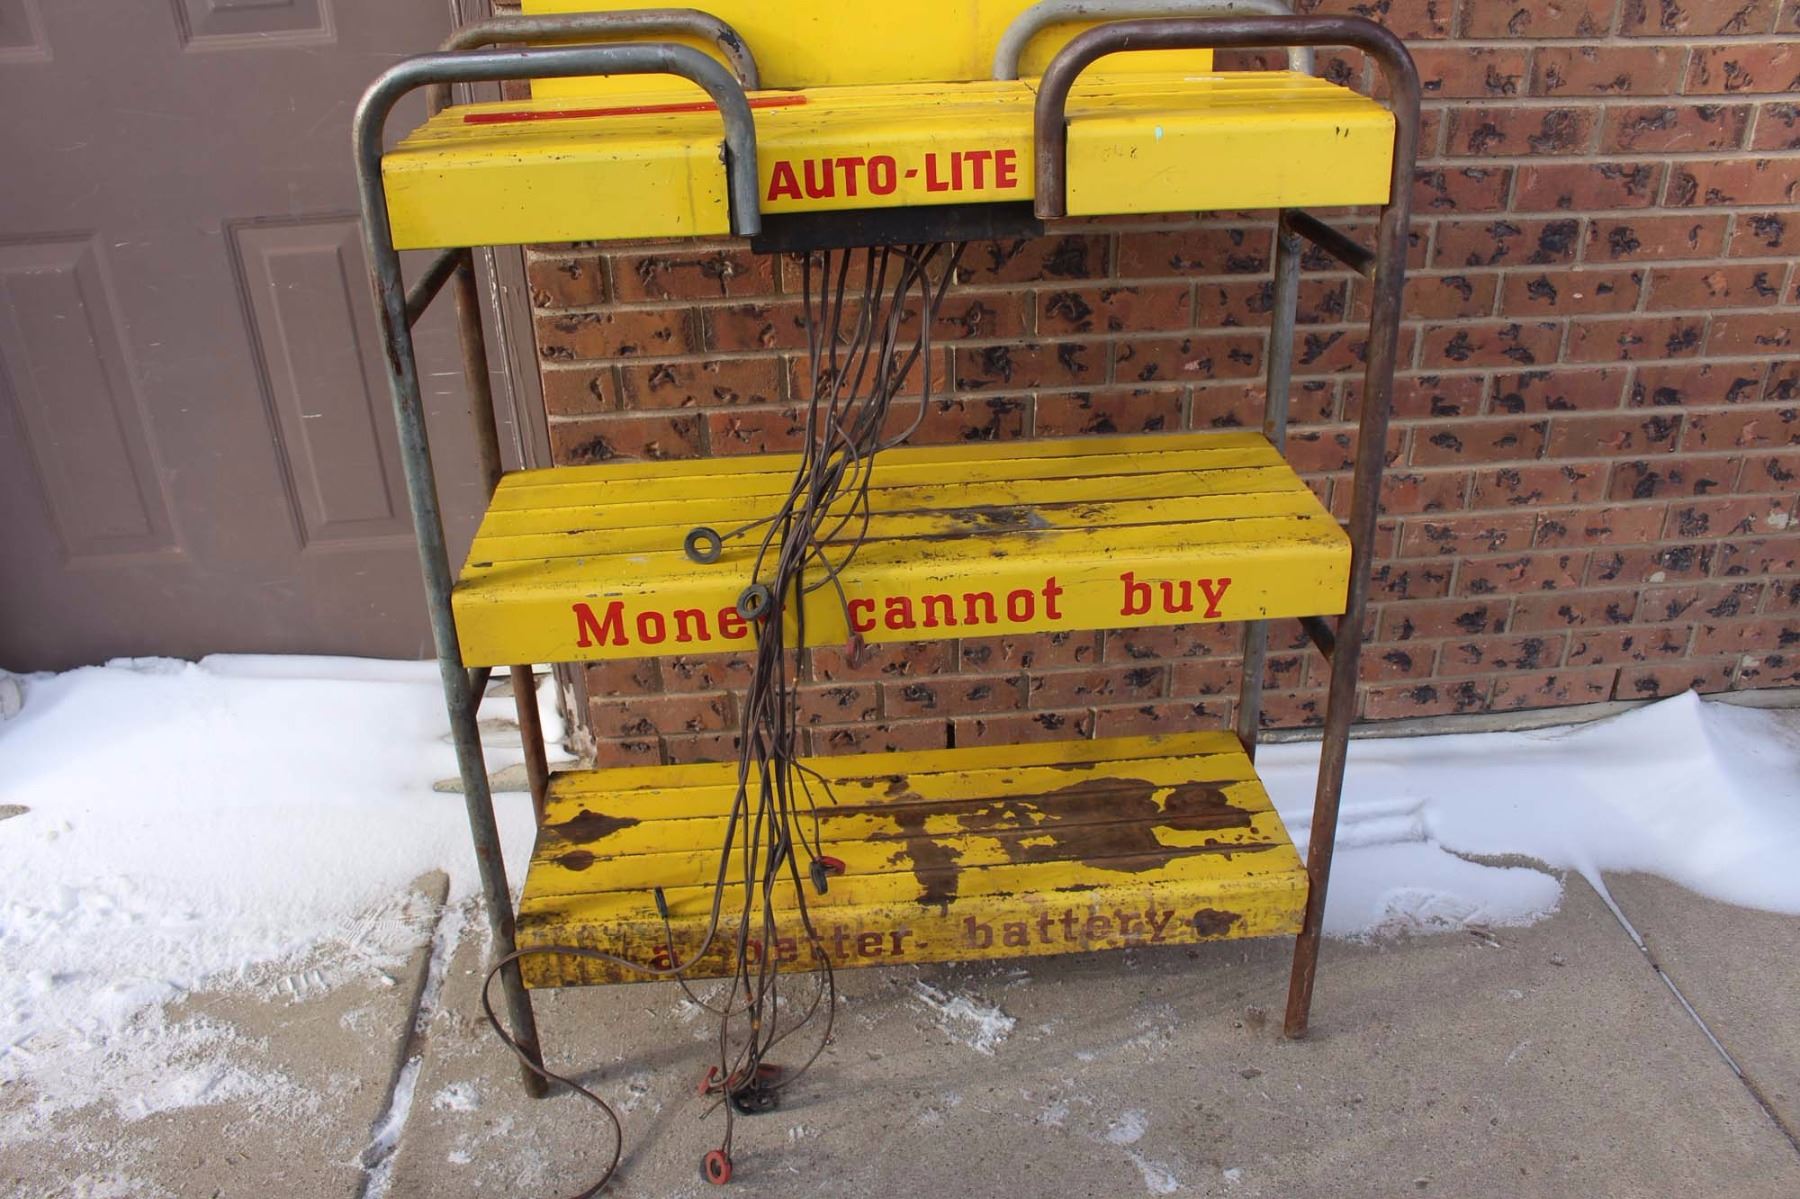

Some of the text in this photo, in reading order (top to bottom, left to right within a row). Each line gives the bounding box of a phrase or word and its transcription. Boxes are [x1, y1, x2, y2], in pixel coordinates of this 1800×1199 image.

[767, 149, 1018, 201] AUTO-LITE
[572, 571, 1231, 648] Mone cannot buy
[963, 908, 1175, 949] battery
